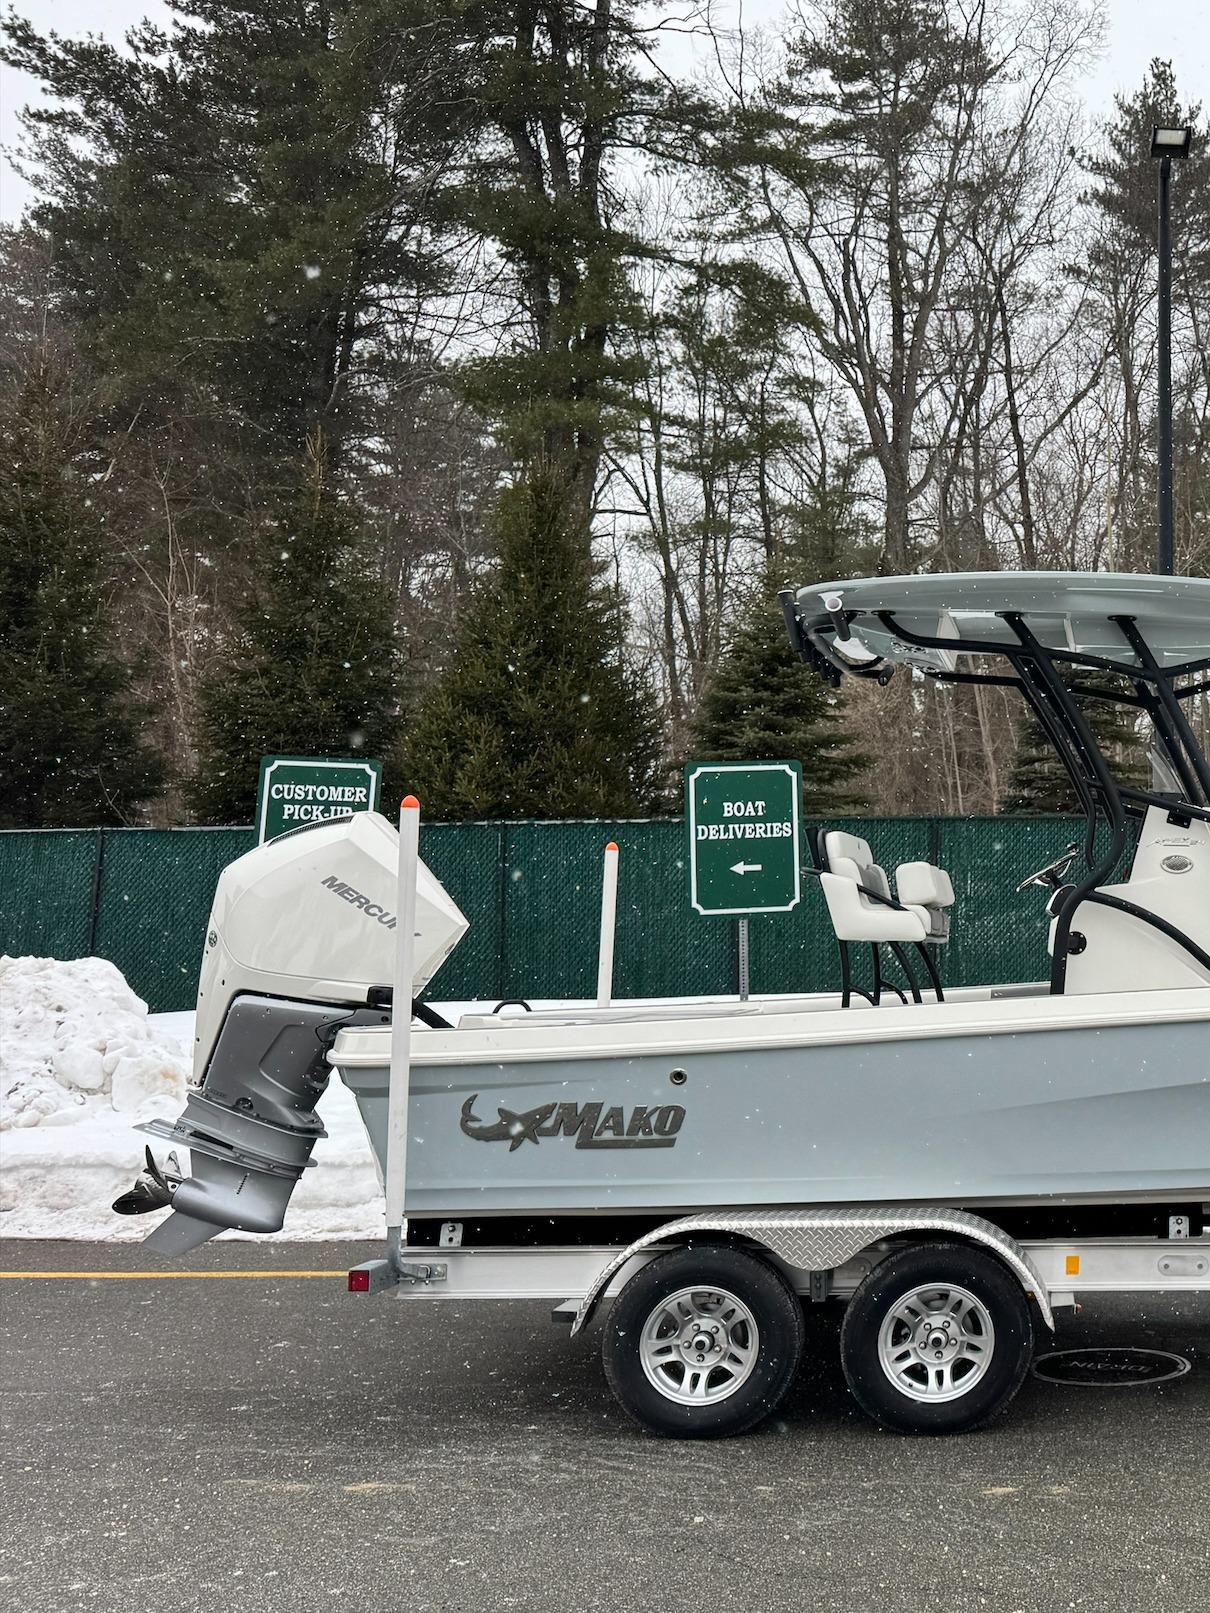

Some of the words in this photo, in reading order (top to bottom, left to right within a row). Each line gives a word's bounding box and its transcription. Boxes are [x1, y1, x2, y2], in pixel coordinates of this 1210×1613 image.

[271, 784, 367, 802] CUSTOMER
[723, 801, 766, 817] BOAT
[697, 822, 793, 840] DELIVERIES
[321, 875, 422, 937] MERCU
[537, 1102, 686, 1149] MAKO
